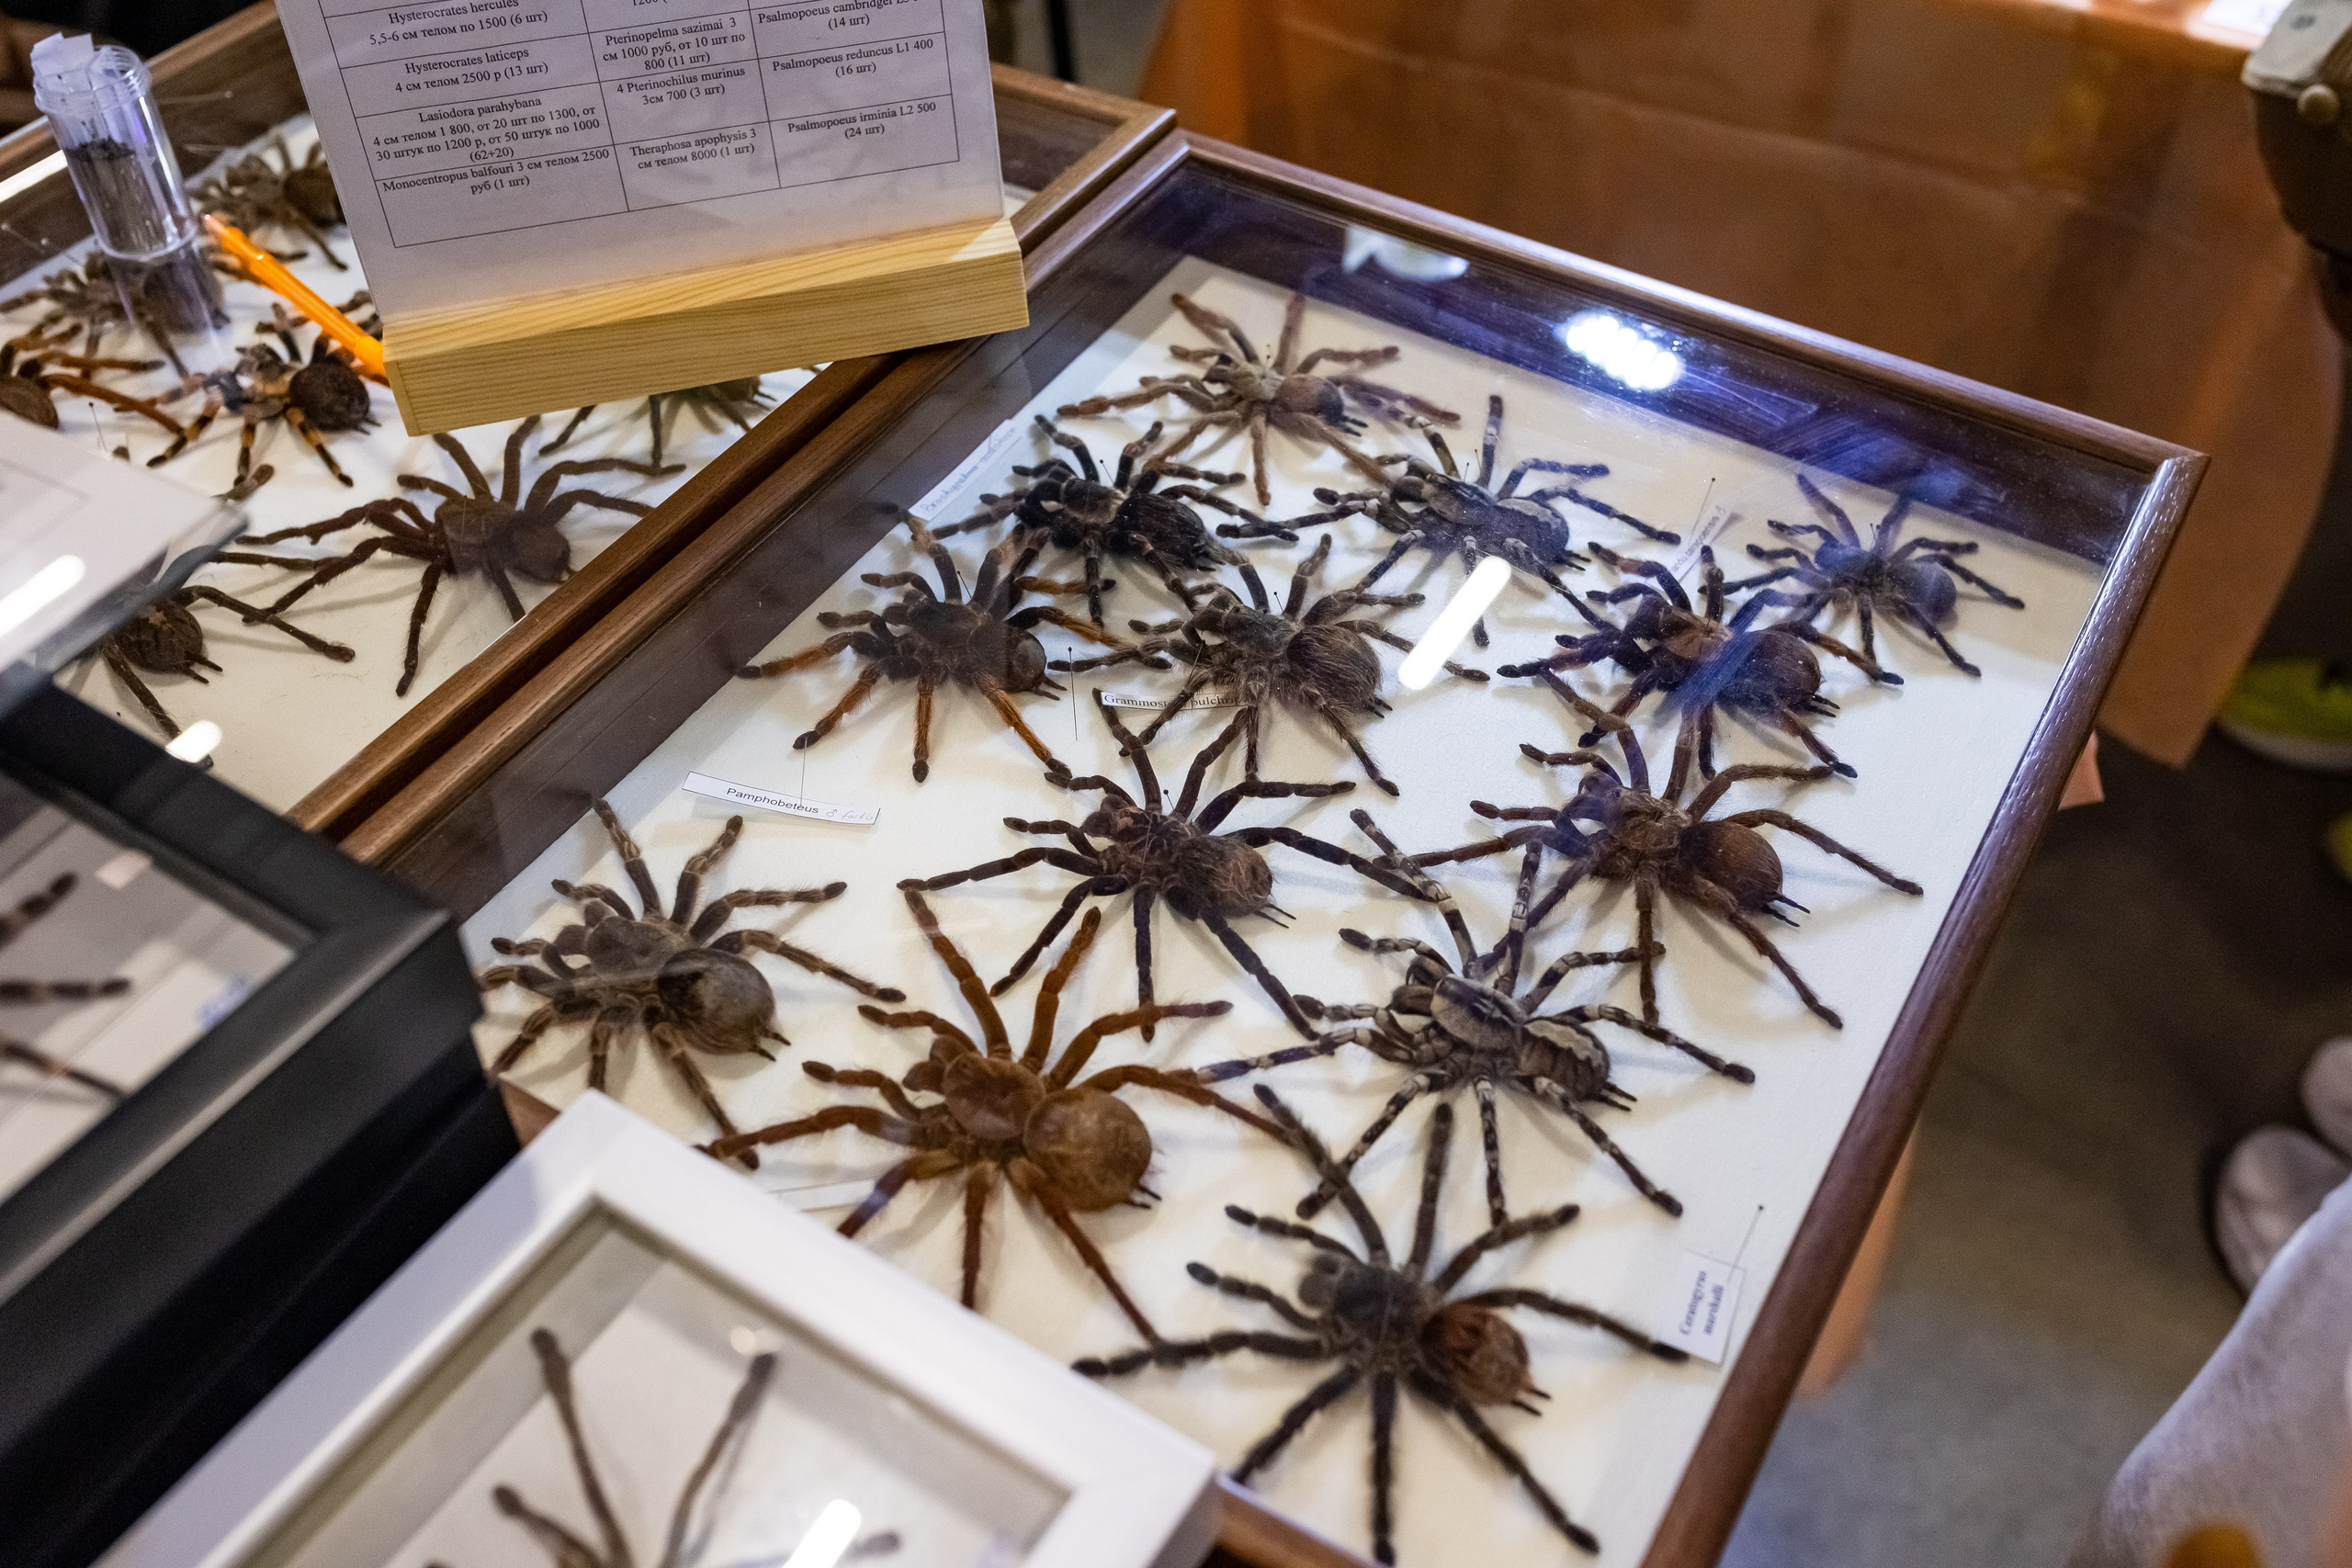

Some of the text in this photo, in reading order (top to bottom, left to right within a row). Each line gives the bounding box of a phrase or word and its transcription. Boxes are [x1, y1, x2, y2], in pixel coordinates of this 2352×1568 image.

[388, 0, 519, 25] Hysterocrates hercules
[758, 6, 831, 24] Psalmopoeus
[828, 14, 870, 30] (14 шт)
[369, 10, 548, 46] 5,5-6 см телом по 1500 (6 шт)
[605, 17, 736, 46] Pterinopelma sazimai 3
[603, 34, 745, 62] см 1000 руб, от 10 шт по
[644, 51, 710, 71] 800 (11 шт)
[773, 39, 933, 72] Psalmopoeus reduncus L1 400
[404, 50, 529, 74] Hysterocrates laticeps
[835, 62, 876, 78] (16 шт)
[395, 62, 548, 93] 4 см телом 2500 р (13 шт)
[616, 68, 745, 94] 4 Pterinochilus murinus
[642, 84, 725, 105] 3см 700 (3 шт)
[418, 98, 542, 122] Lasiodora parahybana
[787, 102, 936, 132] Psalmopoeus irminia L2 500
[373, 107, 595, 146] 4 см телом 1 800, от 20 шт по 1300, от
[376, 118, 600, 161] 30 штук по 1200 р, от 50 штук по 1000
[844, 124, 885, 140] (24 шт)
[469, 147, 514, 163] (62+20)
[629, 128, 756, 156] Theraphosa apophysis 3
[638, 143, 755, 169] см телом 8000 (1 шт)
[382, 149, 609, 192] Monocentropus balfouri 3 см телом 2500
[470, 175, 530, 195] руб (1 шт)
[726, 787, 820, 814] Pamphobeteus
